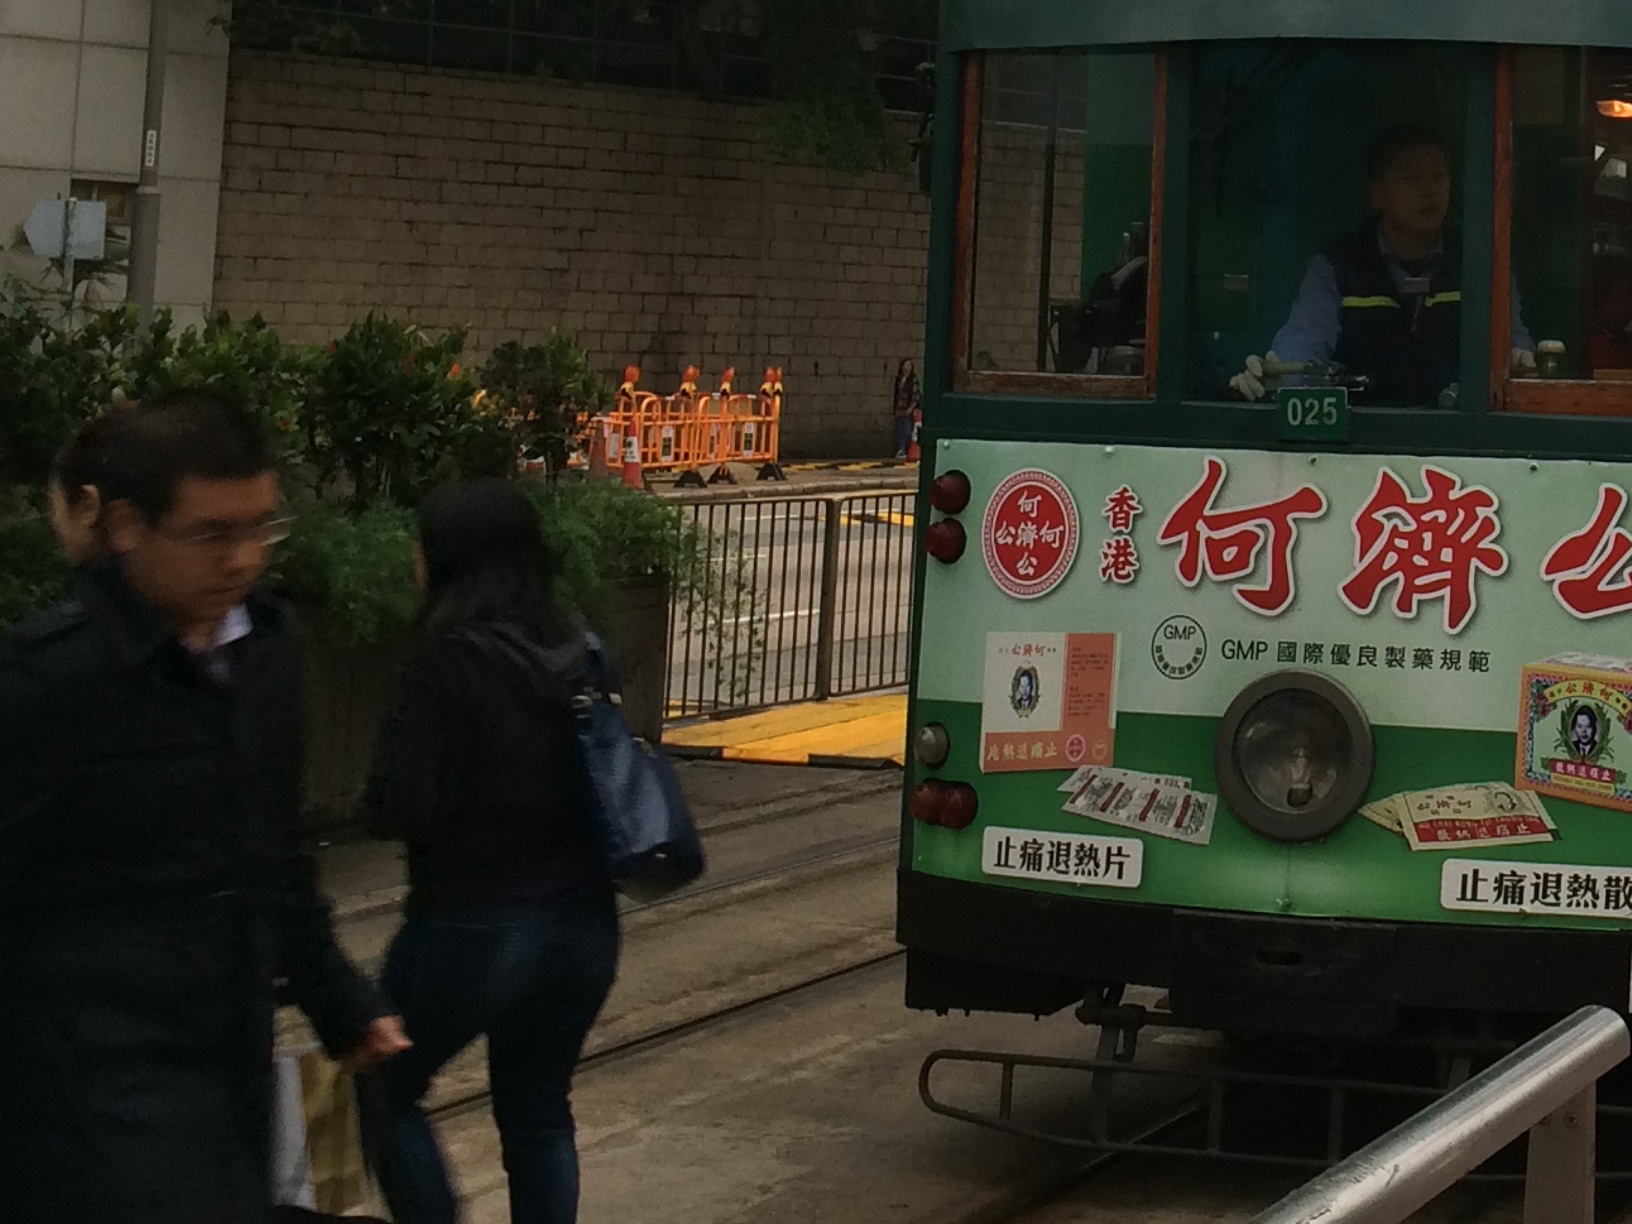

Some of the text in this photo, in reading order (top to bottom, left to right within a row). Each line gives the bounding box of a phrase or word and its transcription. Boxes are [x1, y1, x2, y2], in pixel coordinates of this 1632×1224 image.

[1286, 397, 1338, 426] 025
[1101, 485, 1142, 583] 香港
[1163, 624, 1197, 641] GMP
[1220, 639, 1491, 673] GMP 國際優良製藥規範
[993, 835, 1131, 880] 止痛退熱片
